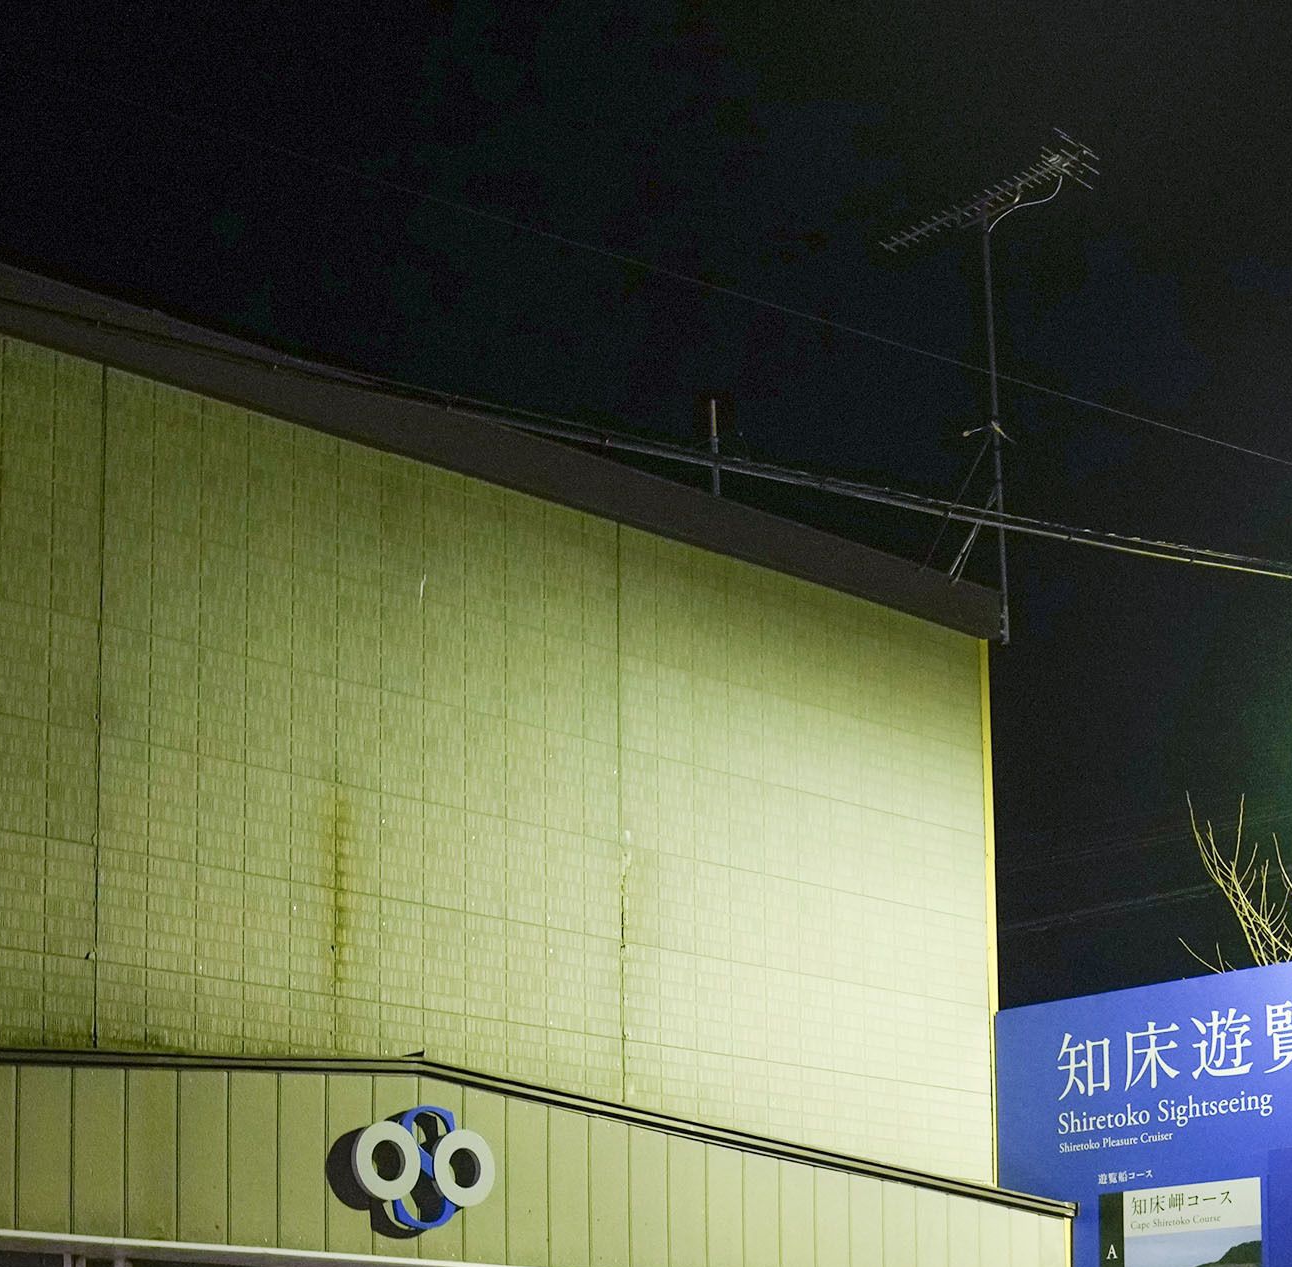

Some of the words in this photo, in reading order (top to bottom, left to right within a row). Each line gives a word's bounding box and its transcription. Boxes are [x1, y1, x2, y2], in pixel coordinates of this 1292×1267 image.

[1058, 1103, 1150, 1135] Shiretoko
[1157, 1091, 1273, 1127] Sightseeing
[1059, 1138, 1100, 1154] Shiretoko
[1102, 1135, 1138, 1148] Pleasure
[1140, 1131, 1174, 1144] Cruiser
[1097, 1169, 1154, 1185] 遊覧船コース
[1131, 1191, 1233, 1216] 知床岬コース
[1130, 1221, 1150, 1232] Cape
[1152, 1215, 1190, 1229] Shiretoko
[1192, 1213, 1222, 1224] Course
[1106, 1245, 1118, 1260] A
